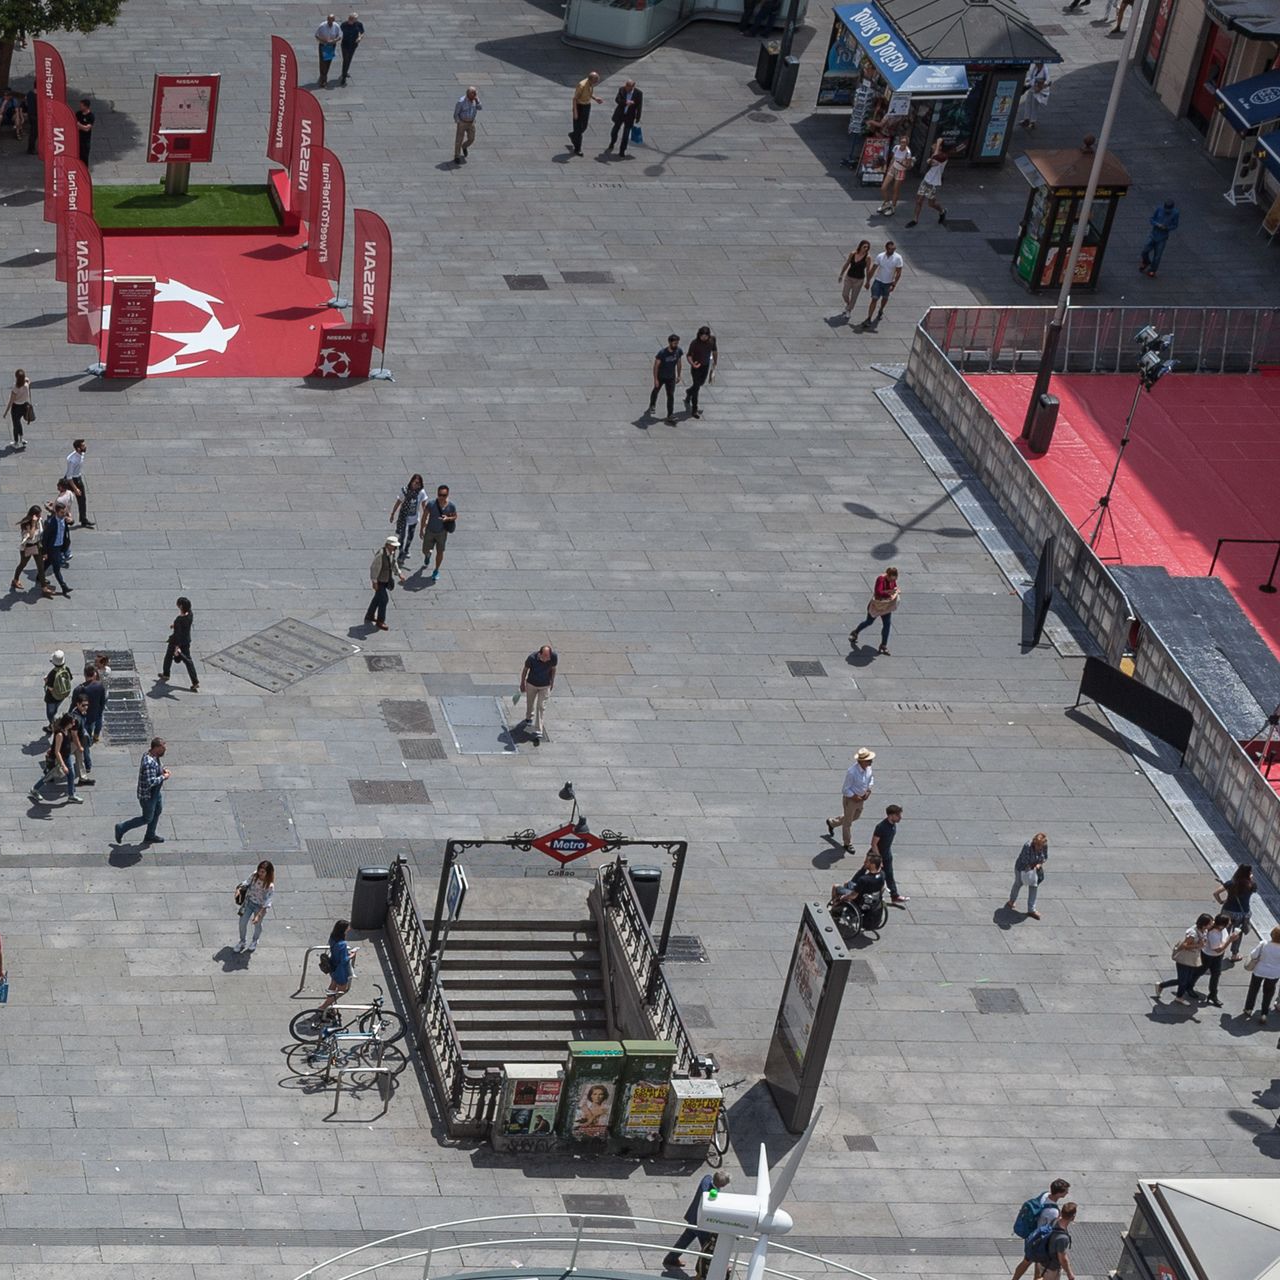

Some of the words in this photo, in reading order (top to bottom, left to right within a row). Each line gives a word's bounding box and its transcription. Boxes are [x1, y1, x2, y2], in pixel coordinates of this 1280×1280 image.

[849, 7, 881, 38] TOURS
[879, 41, 909, 73] TOLEDO
[553, 840, 585, 849] Metro
